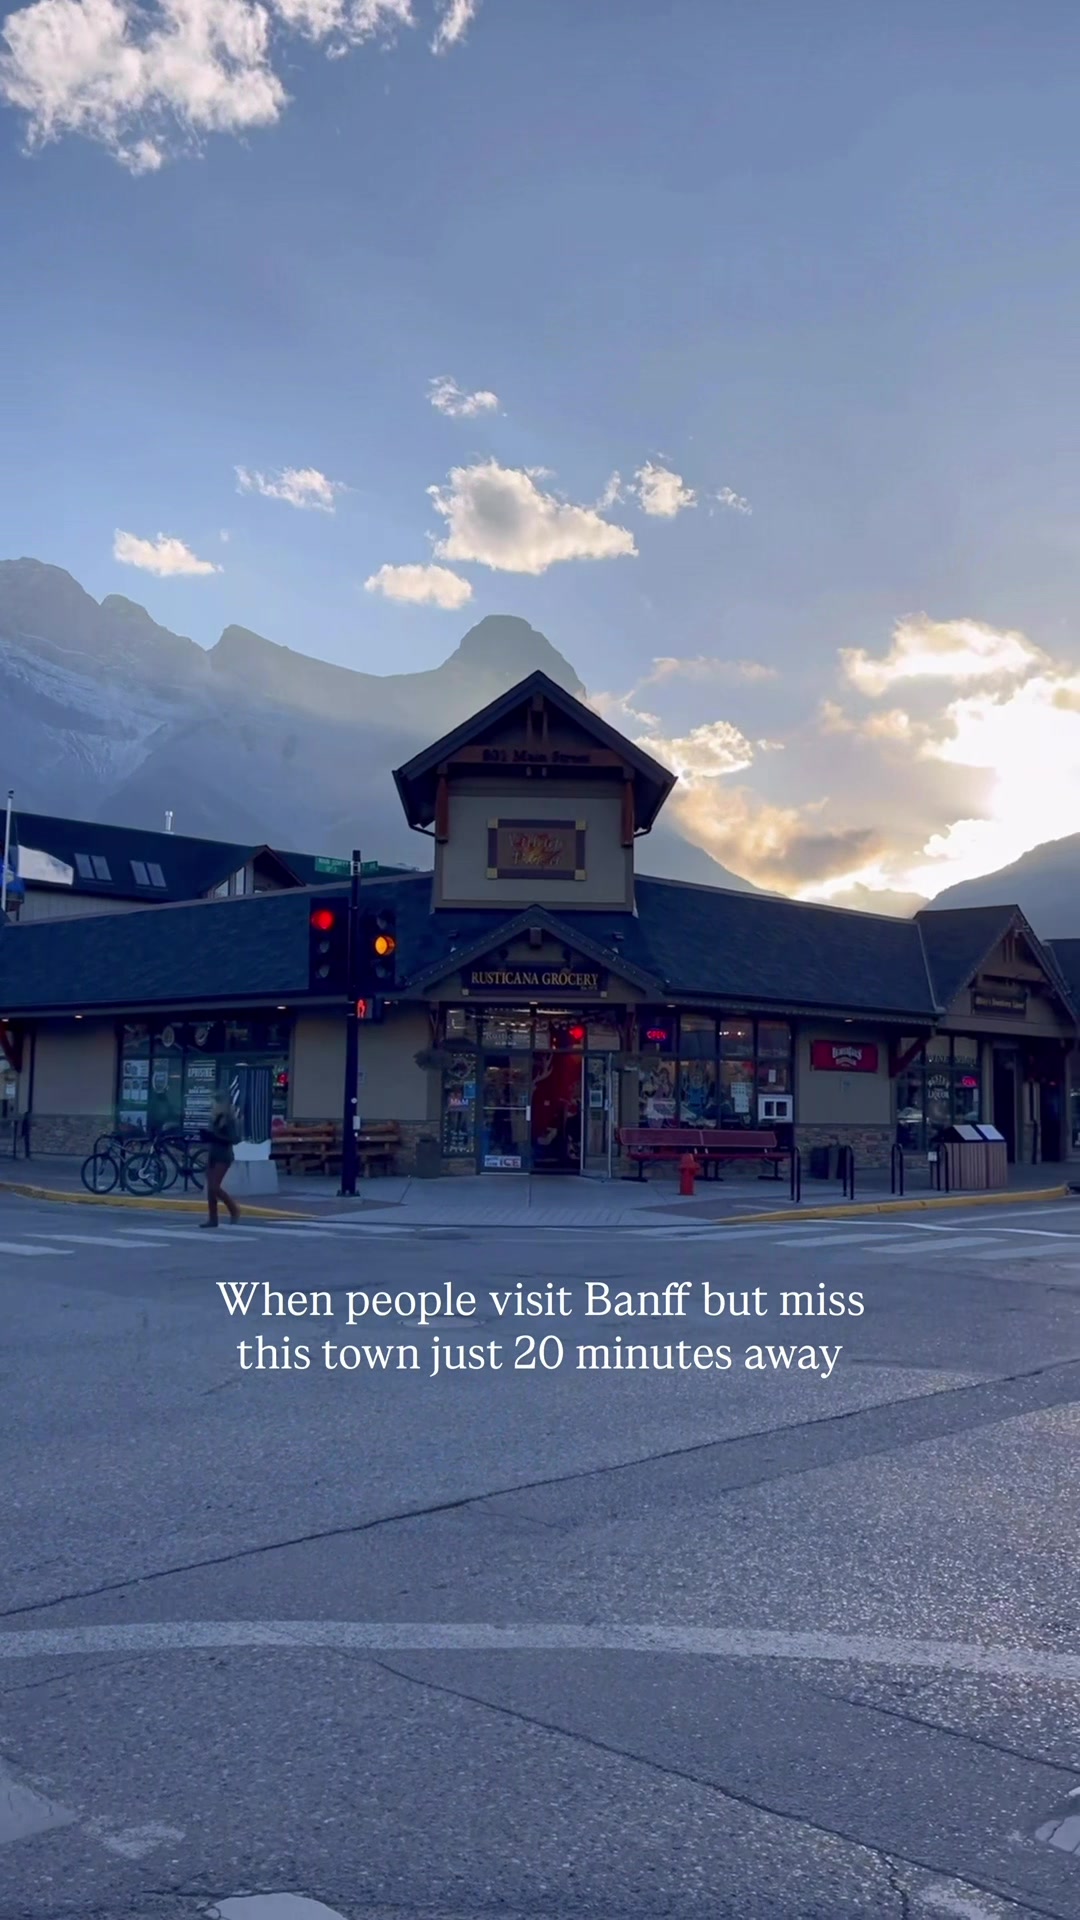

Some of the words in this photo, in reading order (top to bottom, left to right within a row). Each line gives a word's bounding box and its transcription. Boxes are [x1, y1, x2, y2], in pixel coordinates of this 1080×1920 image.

[512, 748, 547, 762] Main
[471, 971, 539, 985] RUSTICANA
[541, 972, 598, 986] GROCERY
[645, 1030, 667, 1040] OPEN
[499, 1157, 520, 1167] ICE
